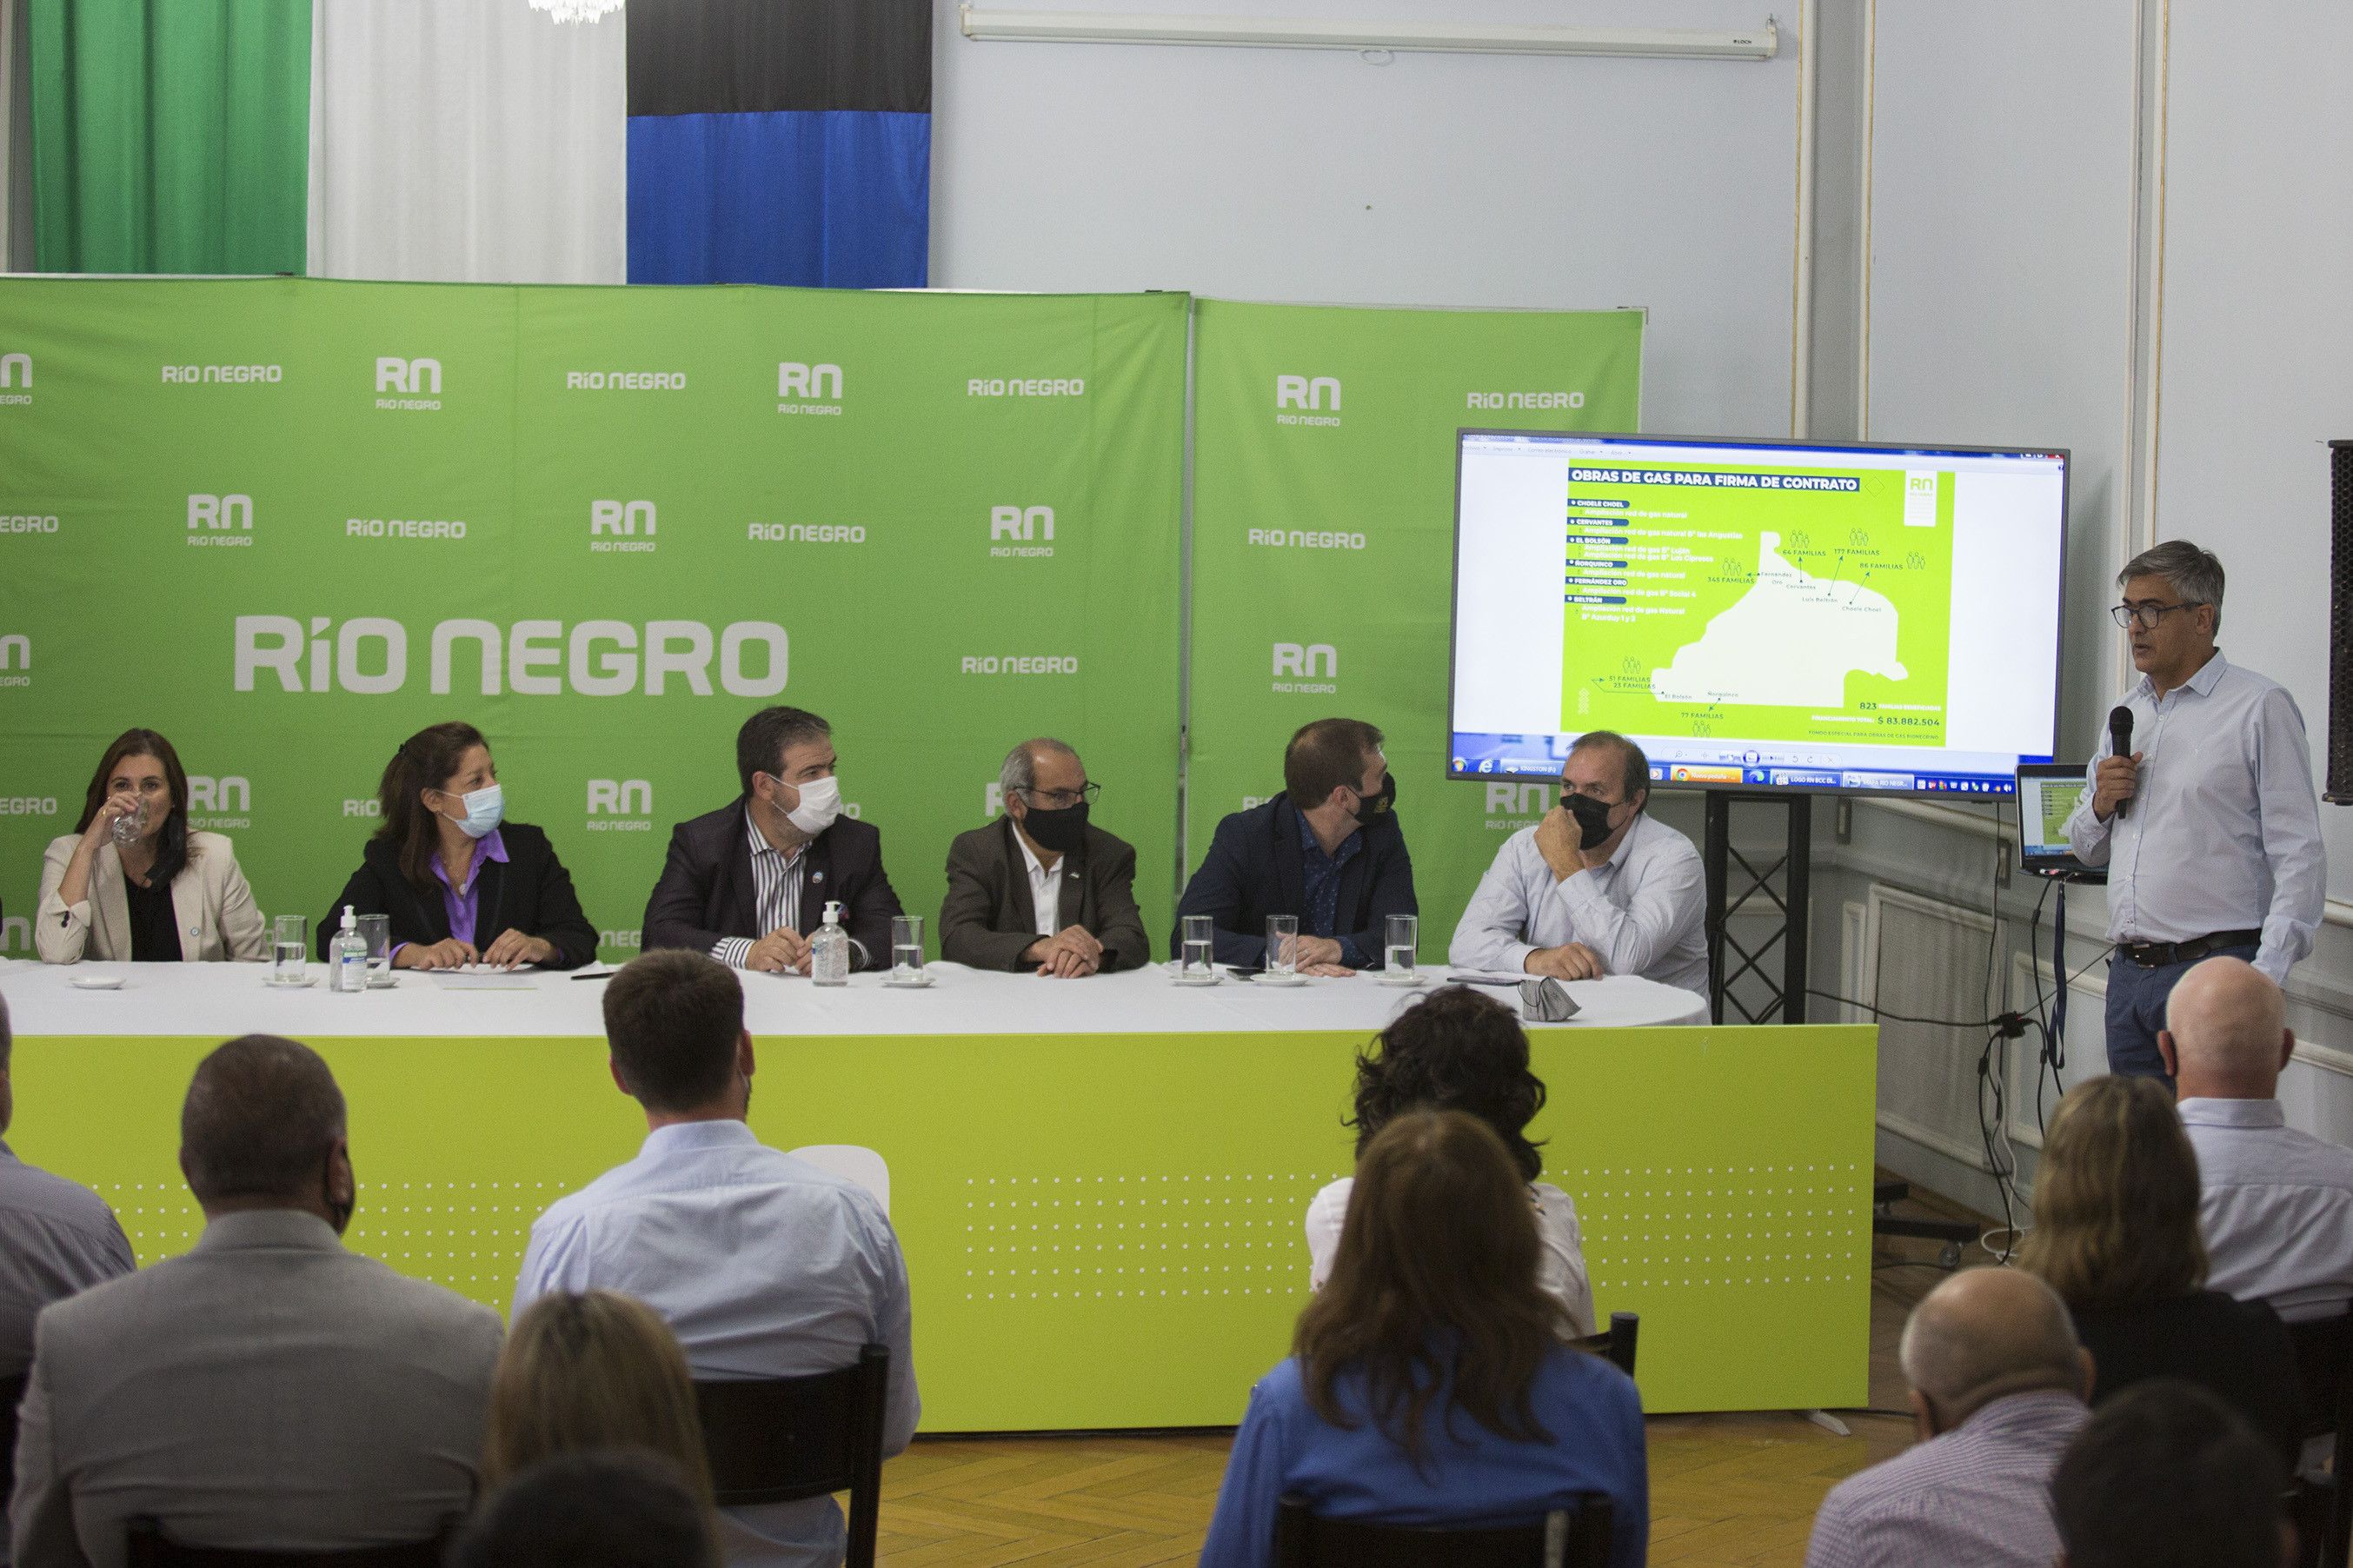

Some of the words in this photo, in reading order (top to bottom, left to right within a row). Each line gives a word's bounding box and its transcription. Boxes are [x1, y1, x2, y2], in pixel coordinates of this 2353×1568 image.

[204, 366, 282, 383] NEGRO
[608, 372, 687, 390] NEGRO
[1008, 378, 1085, 396] NEGRO
[1508, 392, 1585, 409] NEGRO
[1572, 469, 1619, 482] OBRAS
[1621, 471, 1641, 483] DE
[1643, 472, 1672, 485] GAS
[1674, 473, 1712, 486] PARA
[1714, 475, 1758, 488] FIRMA
[1760, 476, 1780, 488] DE
[1782, 477, 1858, 491] CONTRATO
[0, 515, 59, 533] EGRO
[389, 520, 466, 539] NEGRO
[789, 525, 866, 543] NEGRO
[1289, 530, 1366, 549] NEGRO
[430, 619, 790, 698] NEGRO
[1003, 656, 1079, 674] NEGRO
[1878, 716, 1885, 725] $
[1886, 717, 1940, 727] 83.882.504
[0, 797, 57, 815] EGRO
